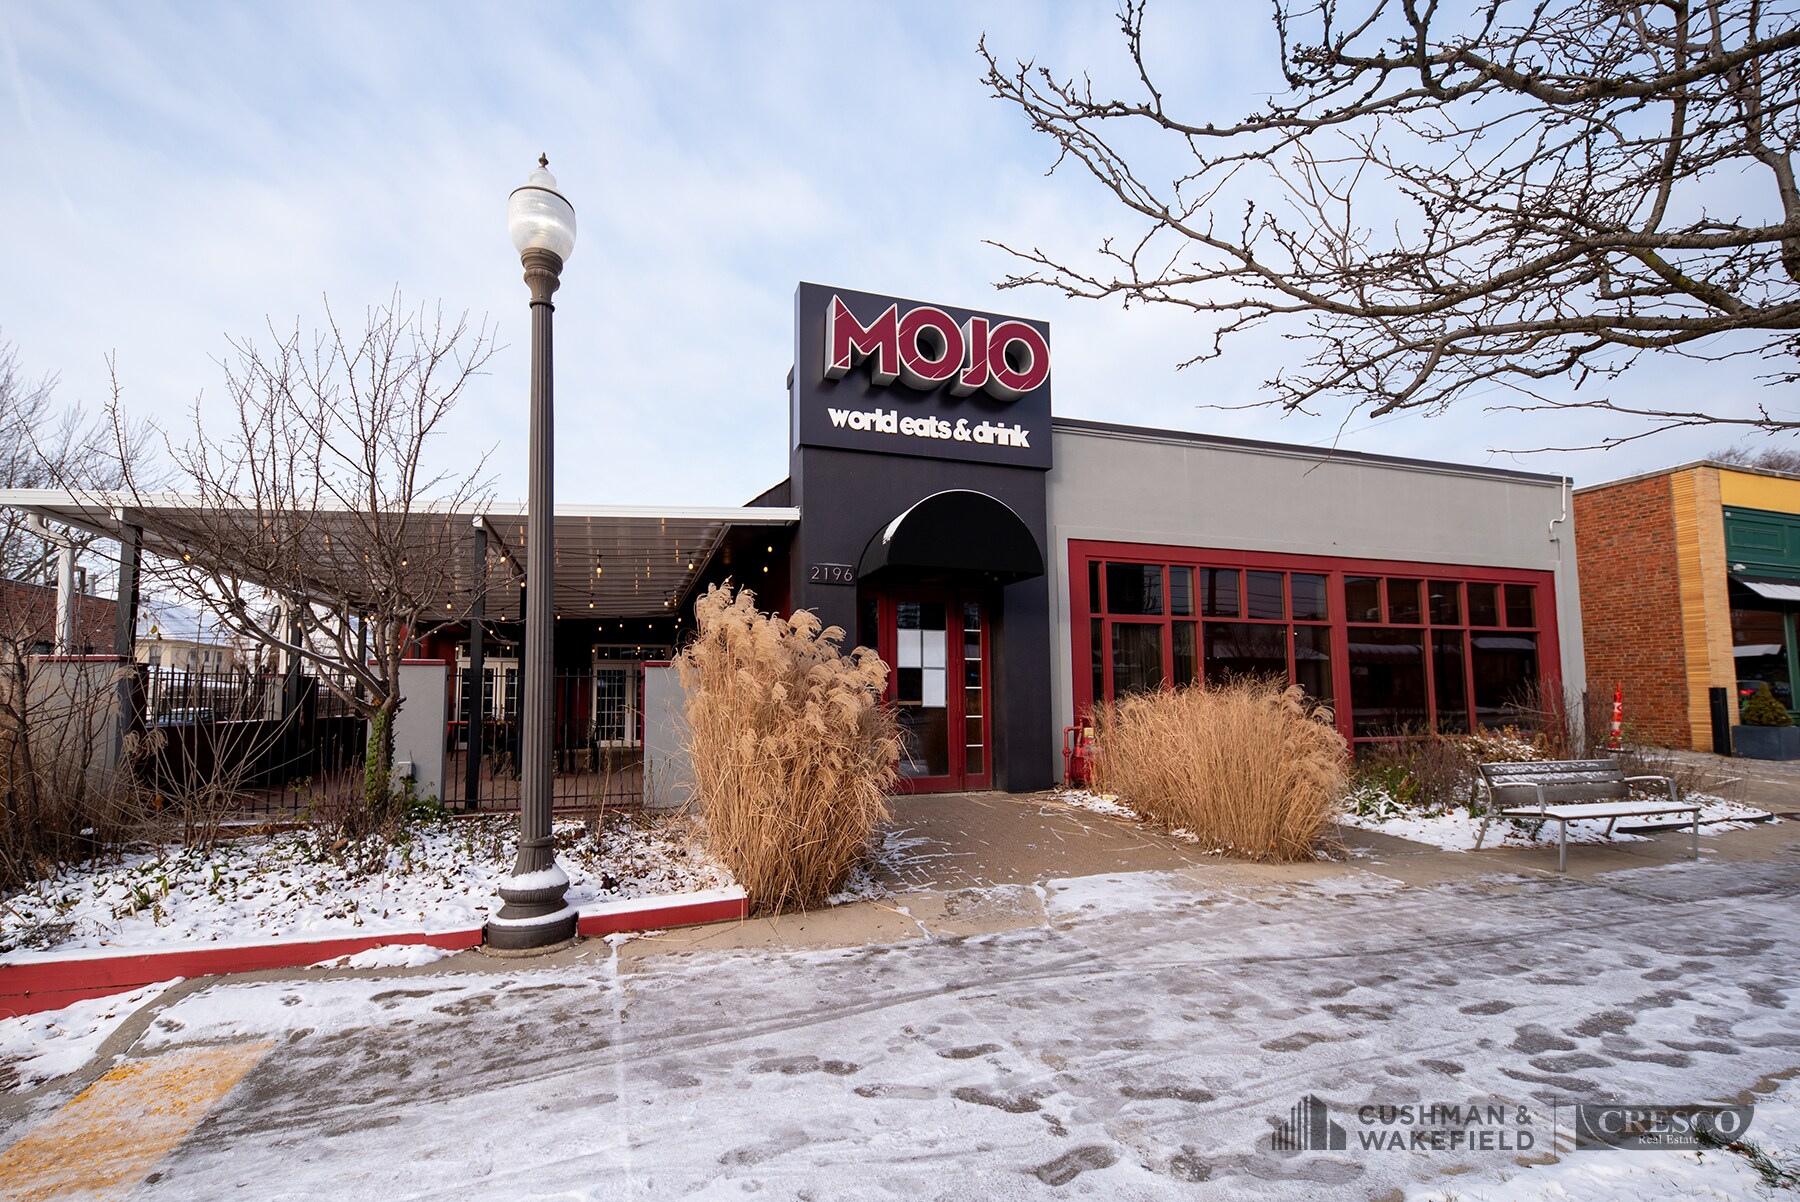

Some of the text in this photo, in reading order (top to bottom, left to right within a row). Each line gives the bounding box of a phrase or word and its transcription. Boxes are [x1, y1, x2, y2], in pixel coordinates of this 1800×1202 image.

[829, 294, 1050, 394] MOJO
[828, 408, 1030, 448] world eats & drink
[811, 566, 853, 582] 2196
